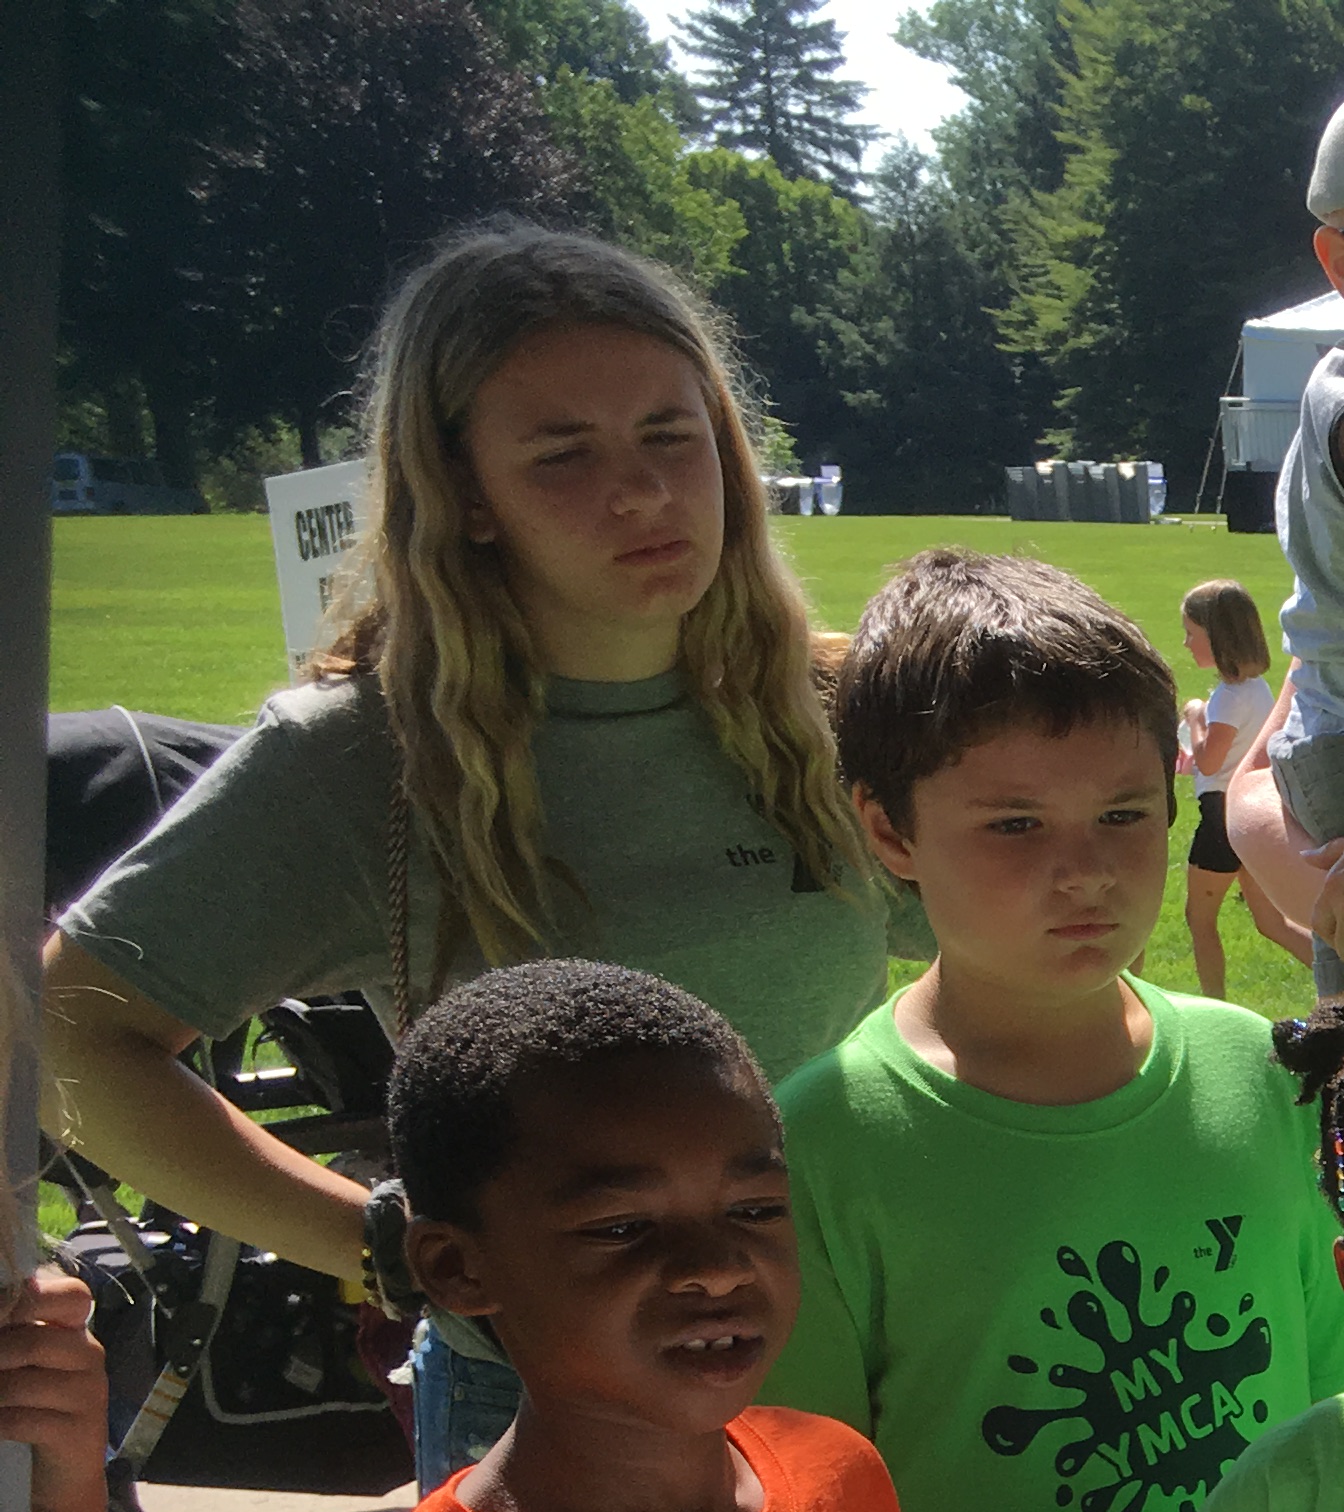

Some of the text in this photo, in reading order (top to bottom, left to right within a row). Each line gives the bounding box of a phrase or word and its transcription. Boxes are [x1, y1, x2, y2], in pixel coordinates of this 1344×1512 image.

[725, 843, 777, 867] the
[1192, 1214, 1243, 1272] the Y
[1110, 1338, 1184, 1412] MY
[1098, 1380, 1244, 1478] YMCA
